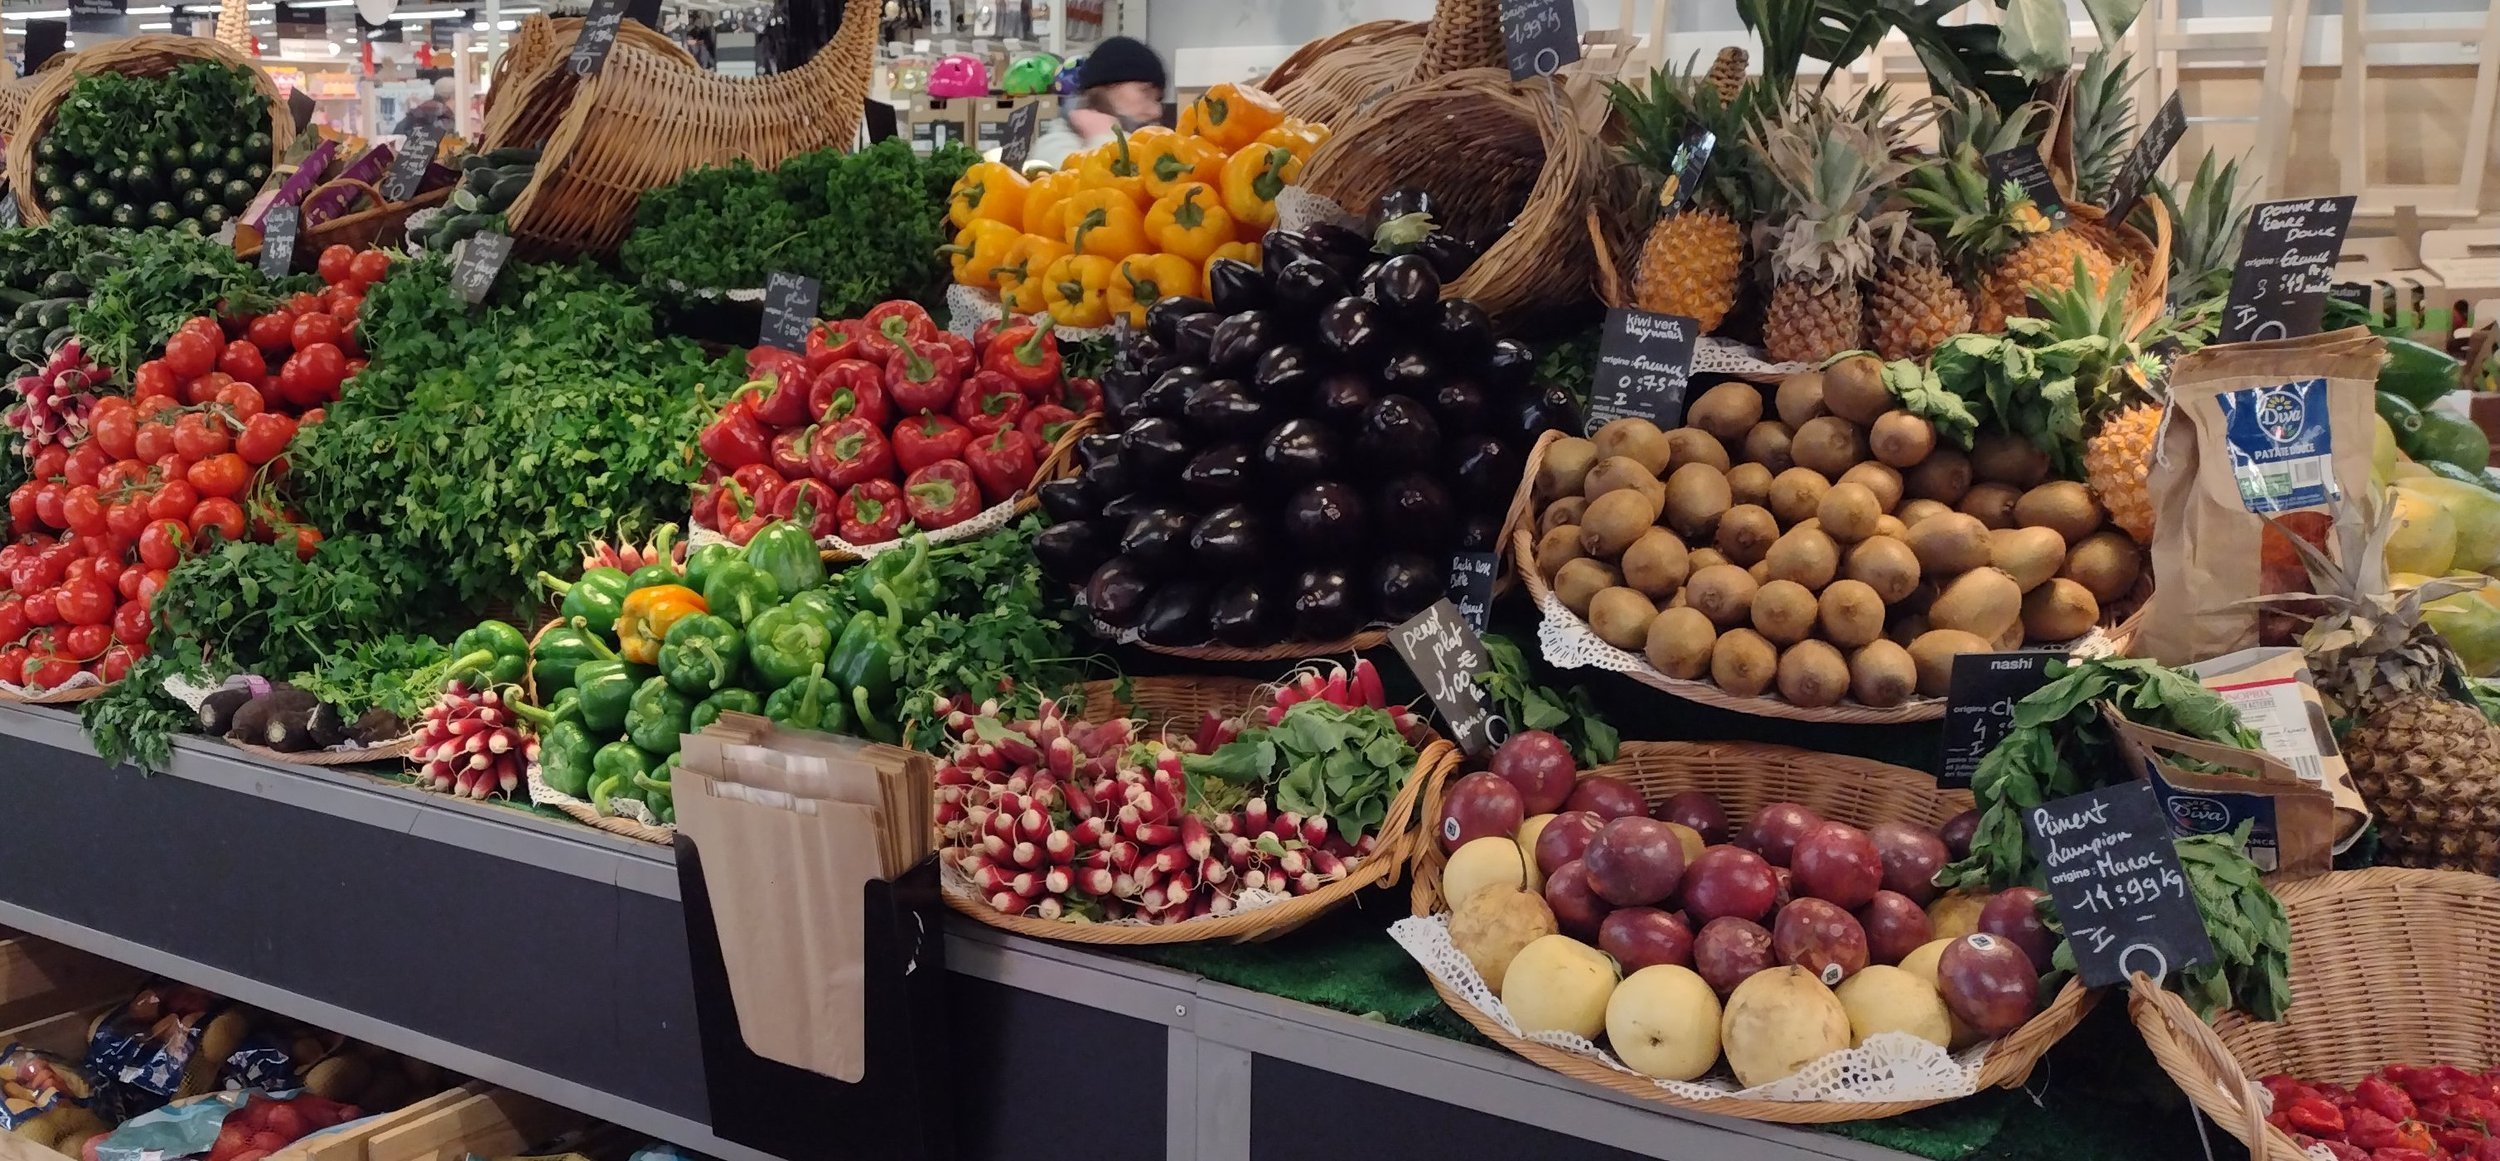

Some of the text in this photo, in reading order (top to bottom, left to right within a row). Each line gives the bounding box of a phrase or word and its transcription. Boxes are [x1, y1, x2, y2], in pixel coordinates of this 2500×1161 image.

[1626, 313, 1680, 331] kiwi vert
[2262, 408, 2301, 425] Diva
[2254, 446, 2290, 460] PATATE
[1991, 658, 2034, 670] nashi
[1992, 696, 2015, 716] Ch
[2172, 801, 2225, 821] Diva
[2095, 851, 2163, 878] Maroc
